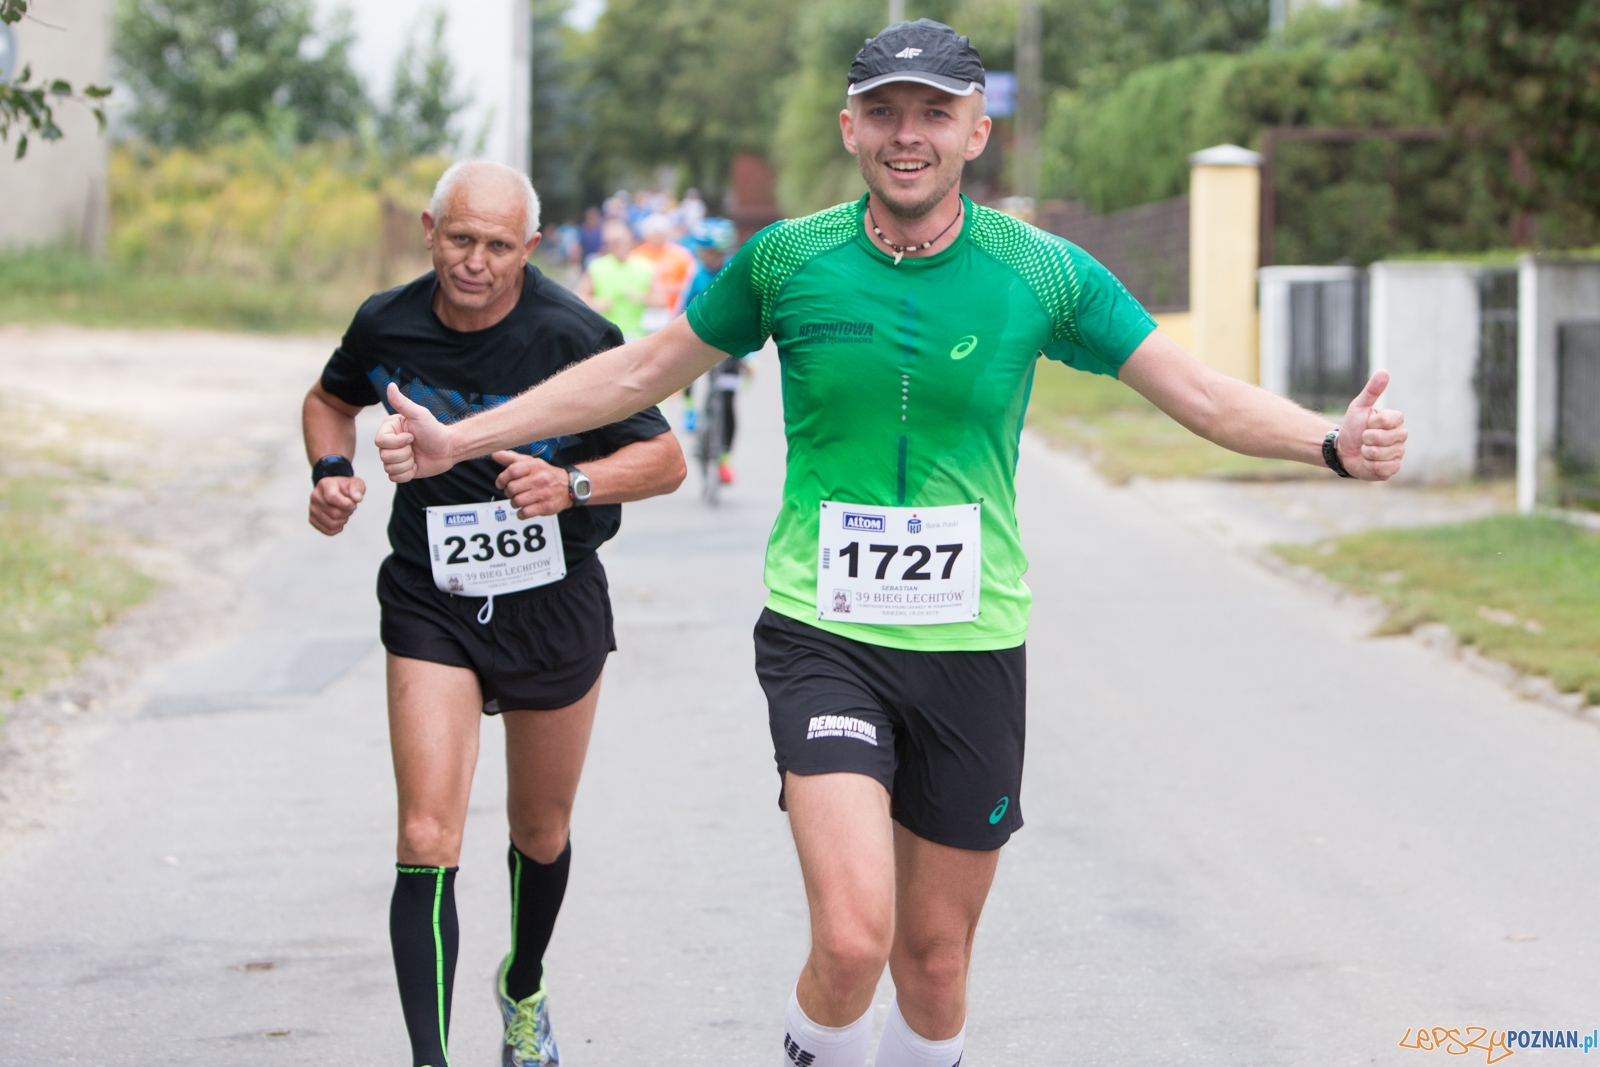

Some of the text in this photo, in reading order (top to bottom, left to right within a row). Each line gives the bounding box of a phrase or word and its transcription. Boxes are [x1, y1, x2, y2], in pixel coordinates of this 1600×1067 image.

[799, 322, 873, 337] REMONTOWA
[444, 524, 546, 565] 2368
[465, 573, 478, 581] 39
[480, 570, 502, 580] BIEG
[505, 557, 552, 575] LECHITÓW
[839, 542, 963, 580] 1727
[855, 590, 965, 603] 39 BIEG LECHITÓW
[808, 715, 876, 739] REMONTOWA
